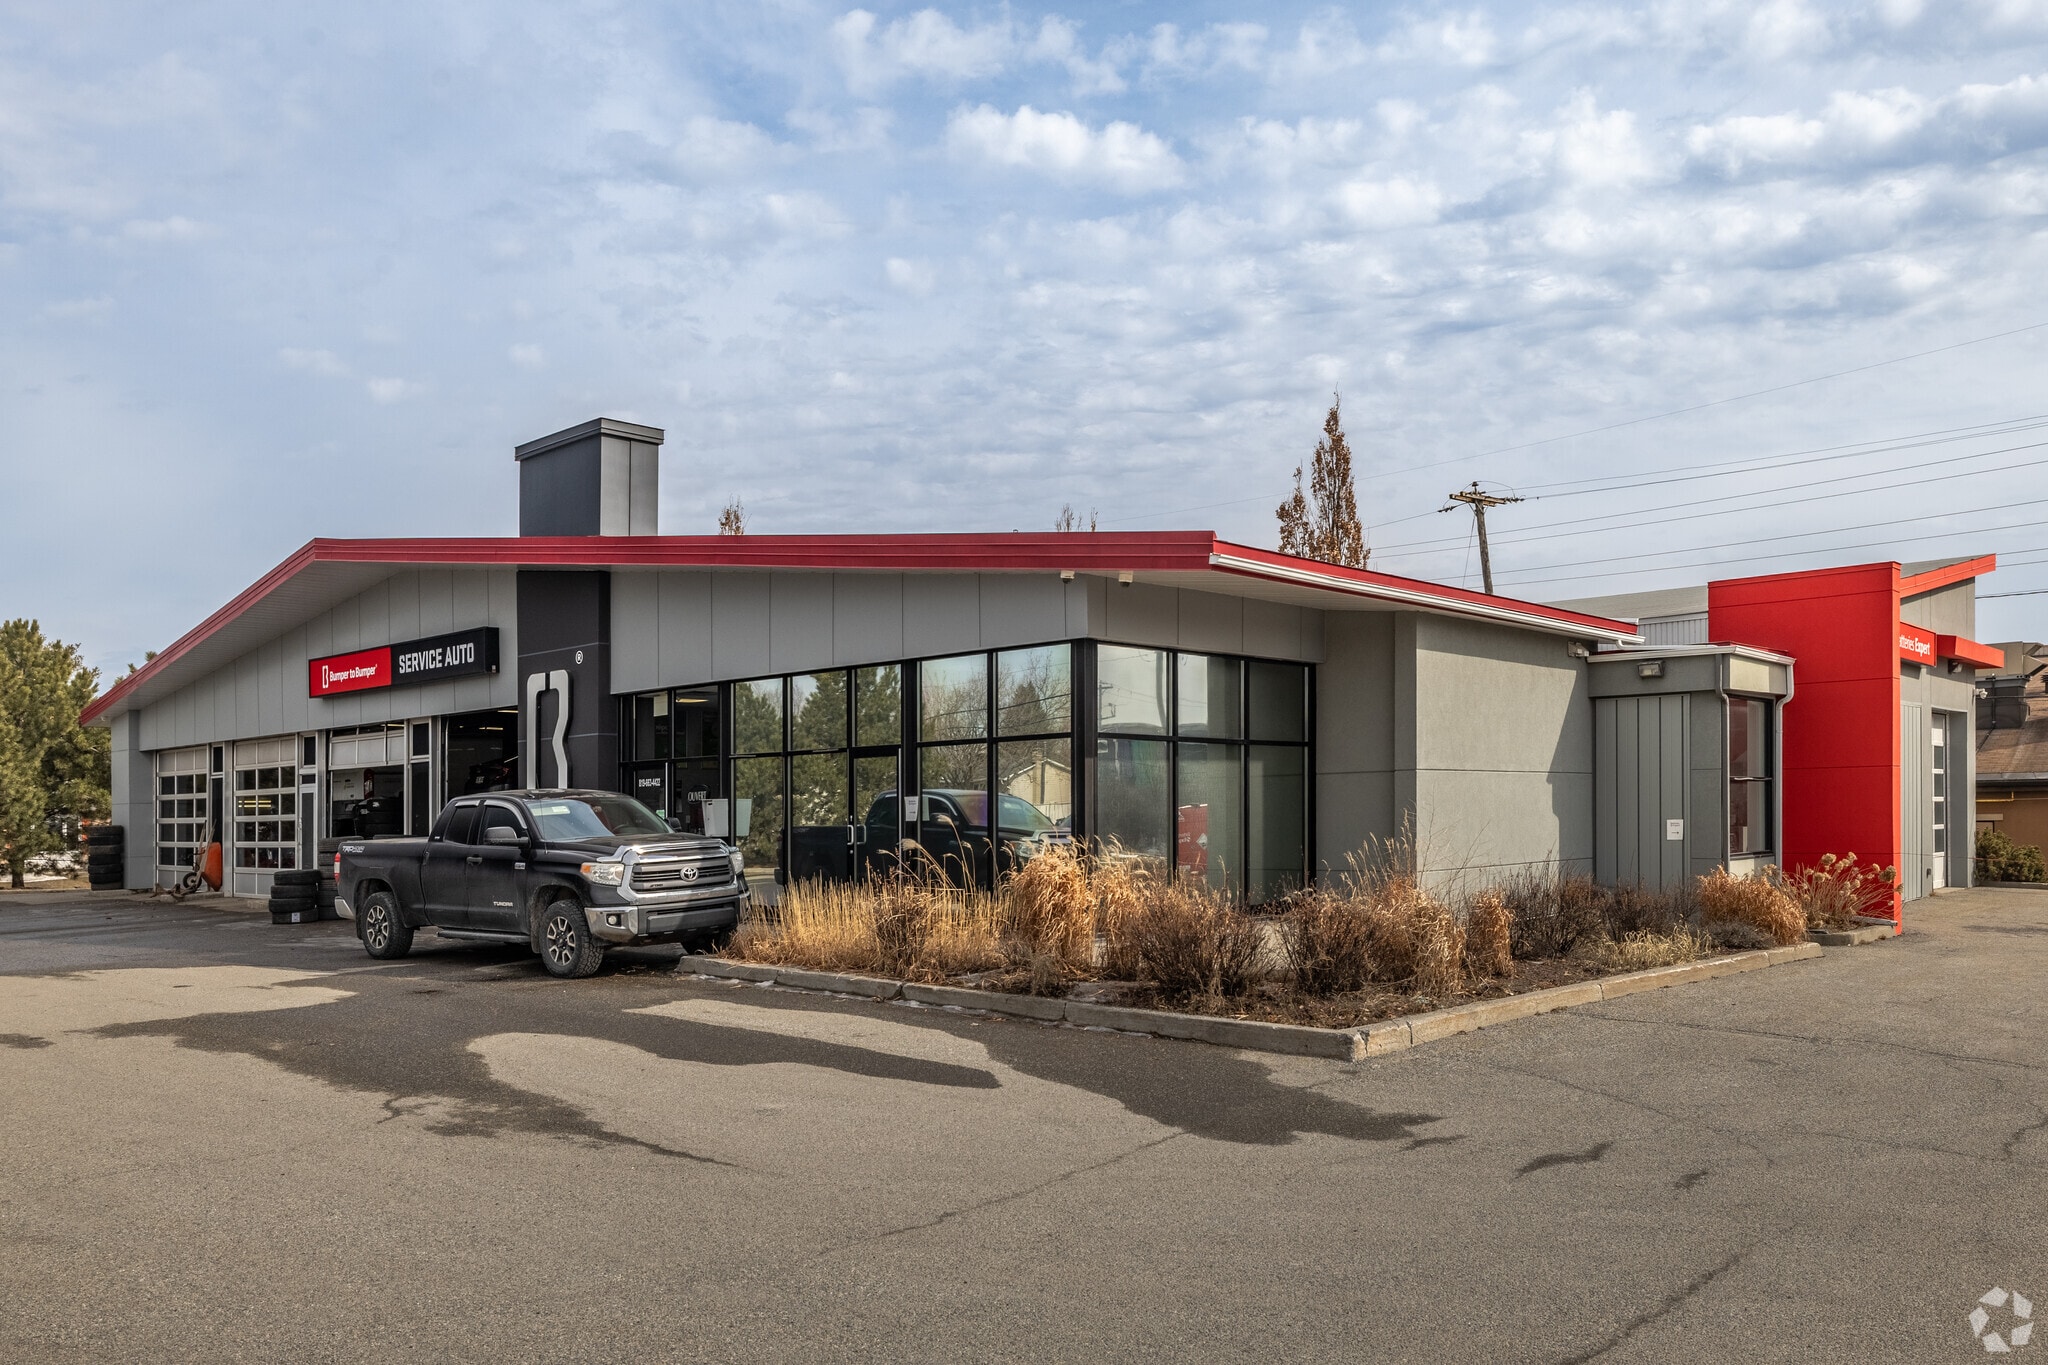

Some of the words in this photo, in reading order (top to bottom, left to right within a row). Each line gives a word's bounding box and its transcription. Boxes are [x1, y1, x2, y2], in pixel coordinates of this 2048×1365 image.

[1914, 637, 1930, 657] Expert
[399, 648, 443, 674] SERVICE
[444, 642, 475, 667] AUTO
[329, 671, 349, 683] Bumper
[349, 669, 356, 679] to
[355, 666, 376, 679] Bumper
